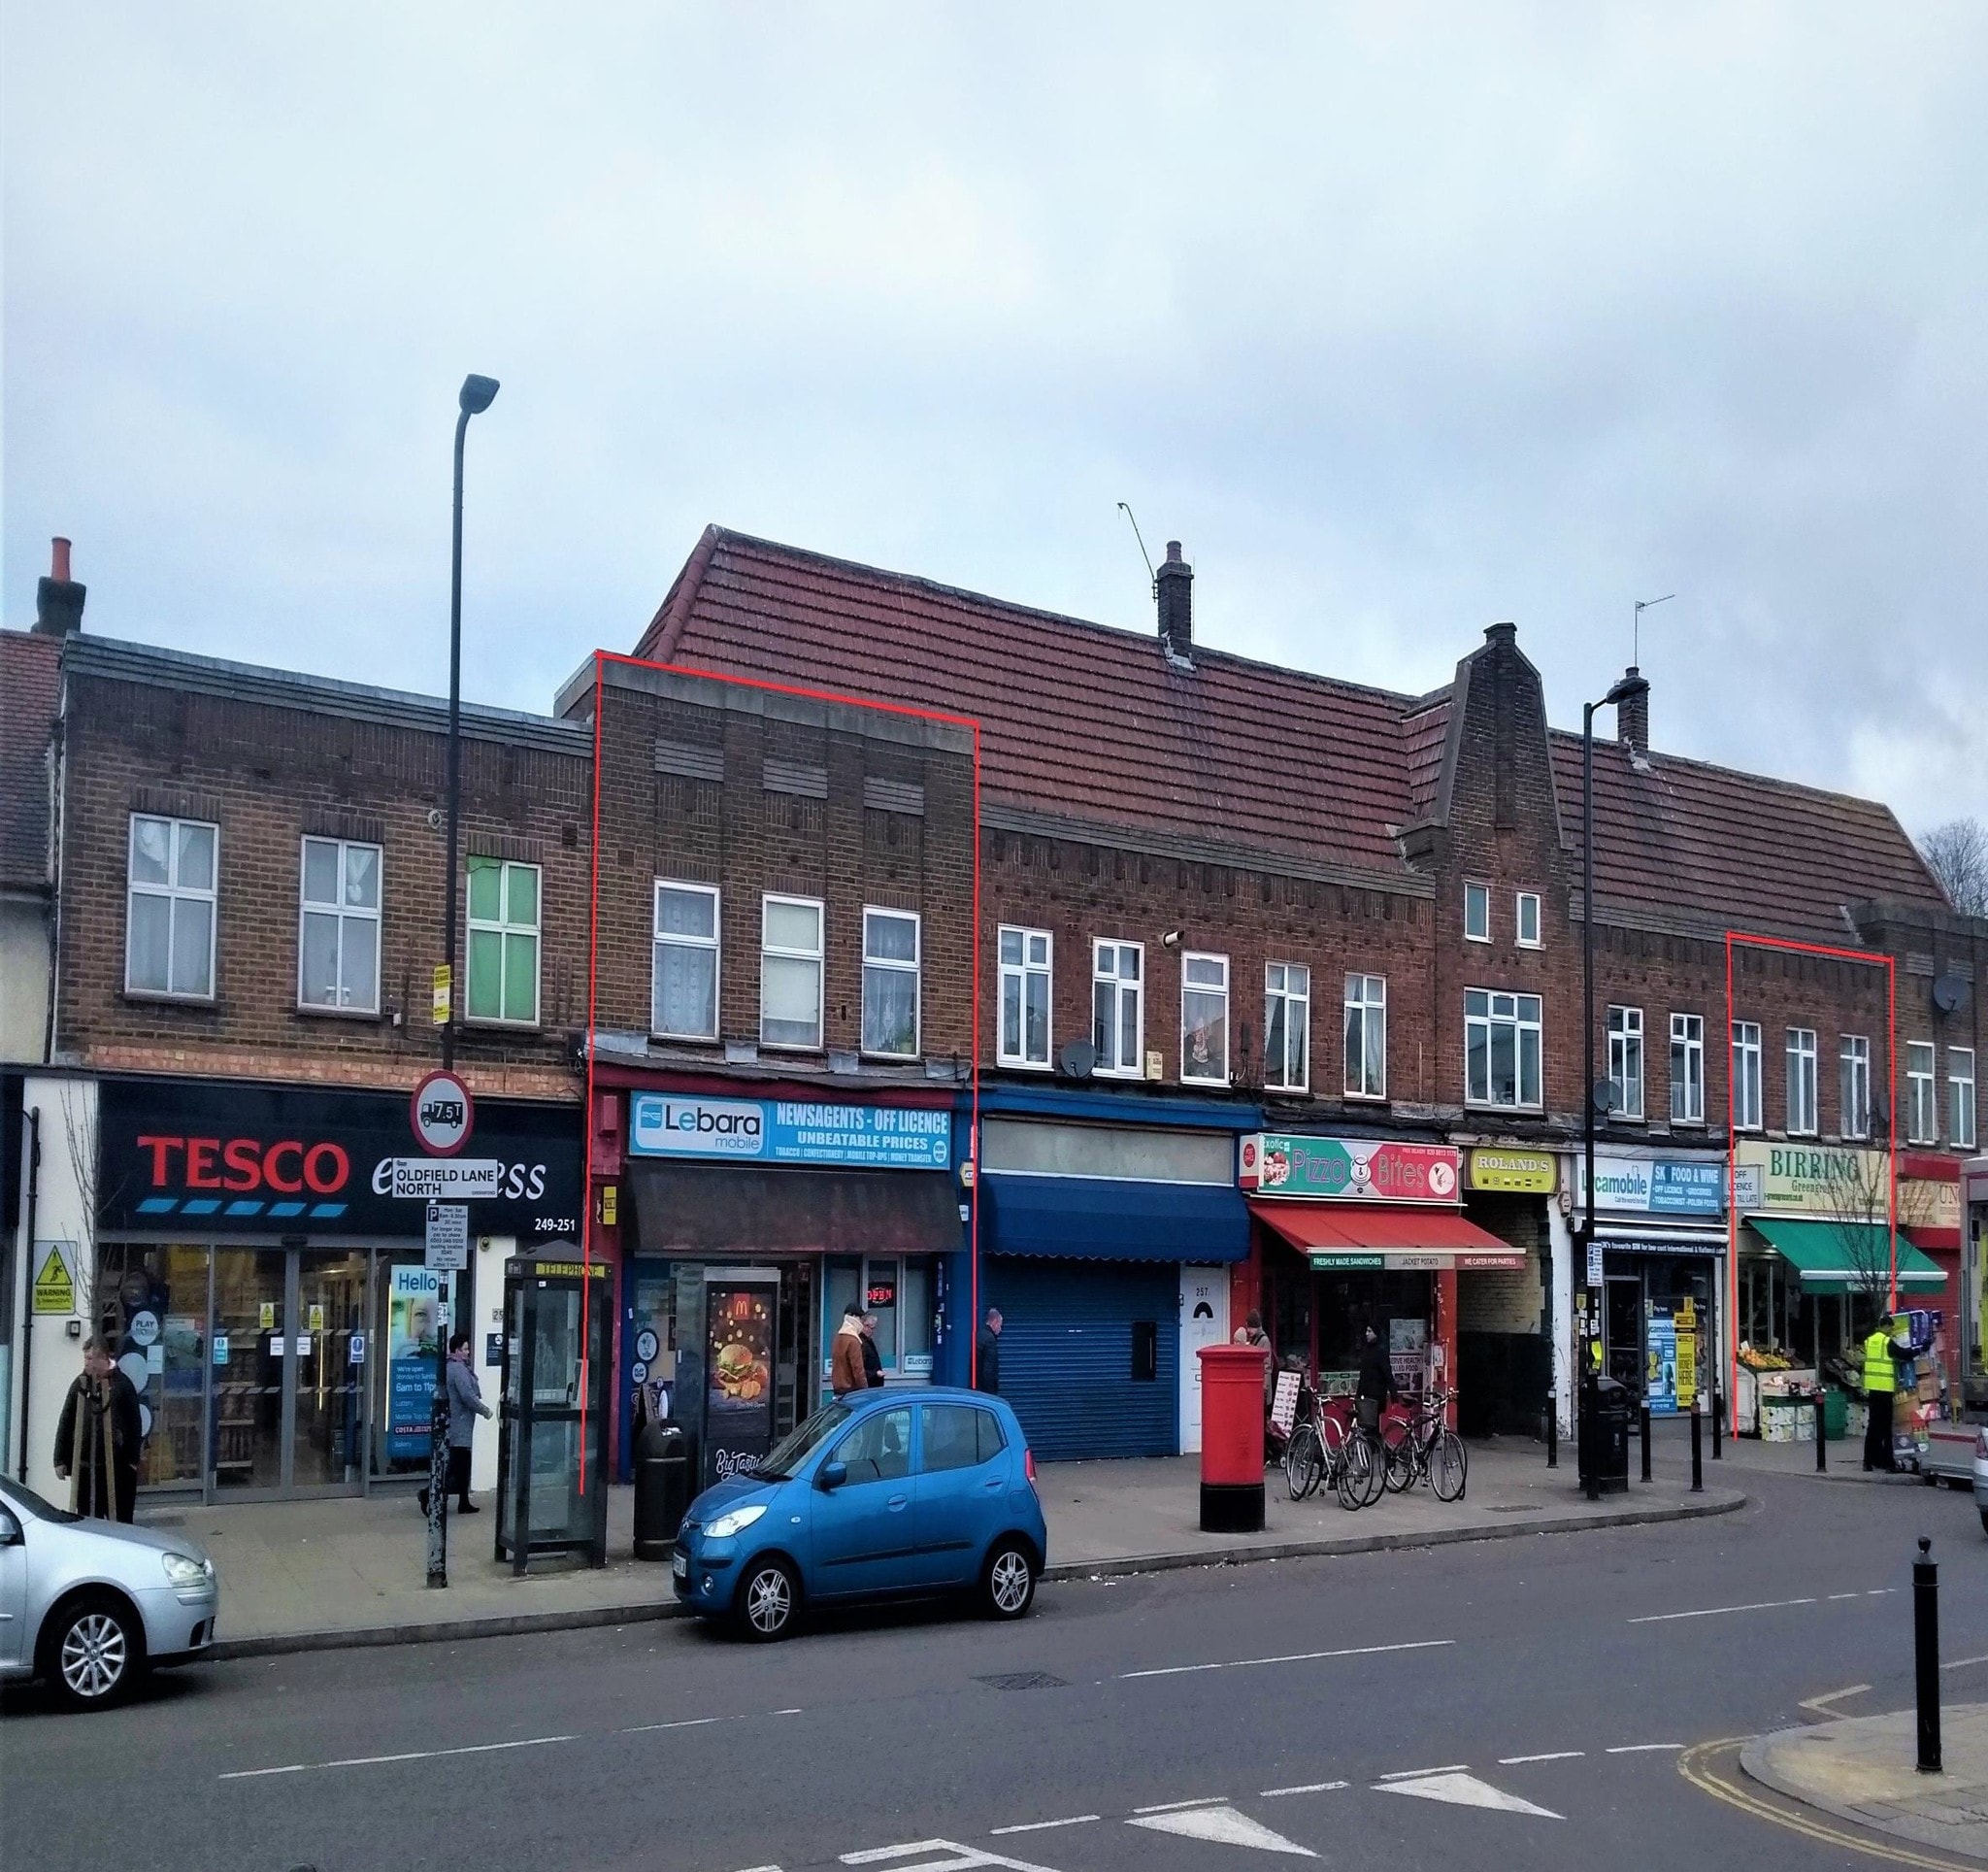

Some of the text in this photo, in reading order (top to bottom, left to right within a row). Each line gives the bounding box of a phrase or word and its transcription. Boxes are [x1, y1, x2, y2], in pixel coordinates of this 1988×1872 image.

[434, 1102, 462, 1120] 7.5T
[777, 1102, 865, 1130] NEWSAGENTS
[875, 1108, 896, 1132] OFF
[898, 1110, 947, 1135] LICENCE
[665, 1104, 760, 1136] Lebara
[714, 1136, 760, 1151] mobile
[797, 1131, 928, 1151] UNBEATABLE PRICES
[776, 1146, 801, 1157] TOBACCO
[803, 1148, 845, 1160] CONFECTIONERY
[846, 1151, 866, 1160] MOBILE
[866, 1151, 887, 1162] TOP-UPS
[137, 1135, 349, 1193] TESCO
[1292, 1149, 1345, 1184] Pizza
[1378, 1153, 1425, 1188] Bites
[1477, 1155, 1549, 1172] ROLAND'S
[1770, 1150, 1859, 1182] BIRRING
[396, 1169, 494, 1182] OLDFIELD LANE
[1655, 1165, 1719, 1185] SK FOOD & WINE
[1735, 1170, 1747, 1179] OFF
[396, 1183, 442, 1195] NORTH
[1581, 1169, 1647, 1196] Lcamobile
[1664, 1186, 1683, 1194] LICENCE
[1728, 1182, 1753, 1191] LCENCE
[1723, 1194, 1737, 1203] OPN
[1746, 1194, 1758, 1203] LATE
[1939, 1185, 1961, 1204] UN
[429, 1208, 438, 1221] P
[535, 1218, 576, 1232] 249-251
[1313, 1257, 1381, 1266] FRESHLY MADE SANDWICHES
[1419, 1257, 1439, 1266] POTATO
[544, 1264, 598, 1277] TELEPHONE
[398, 1273, 437, 1290] Hello
[36, 1288, 71, 1297] WARNING
[867, 1289, 892, 1300] OPEN
[1196, 1287, 1209, 1297] 257
[395, 1382, 437, 1393] 6am to 11p
[715, 1449, 736, 1482] Big
